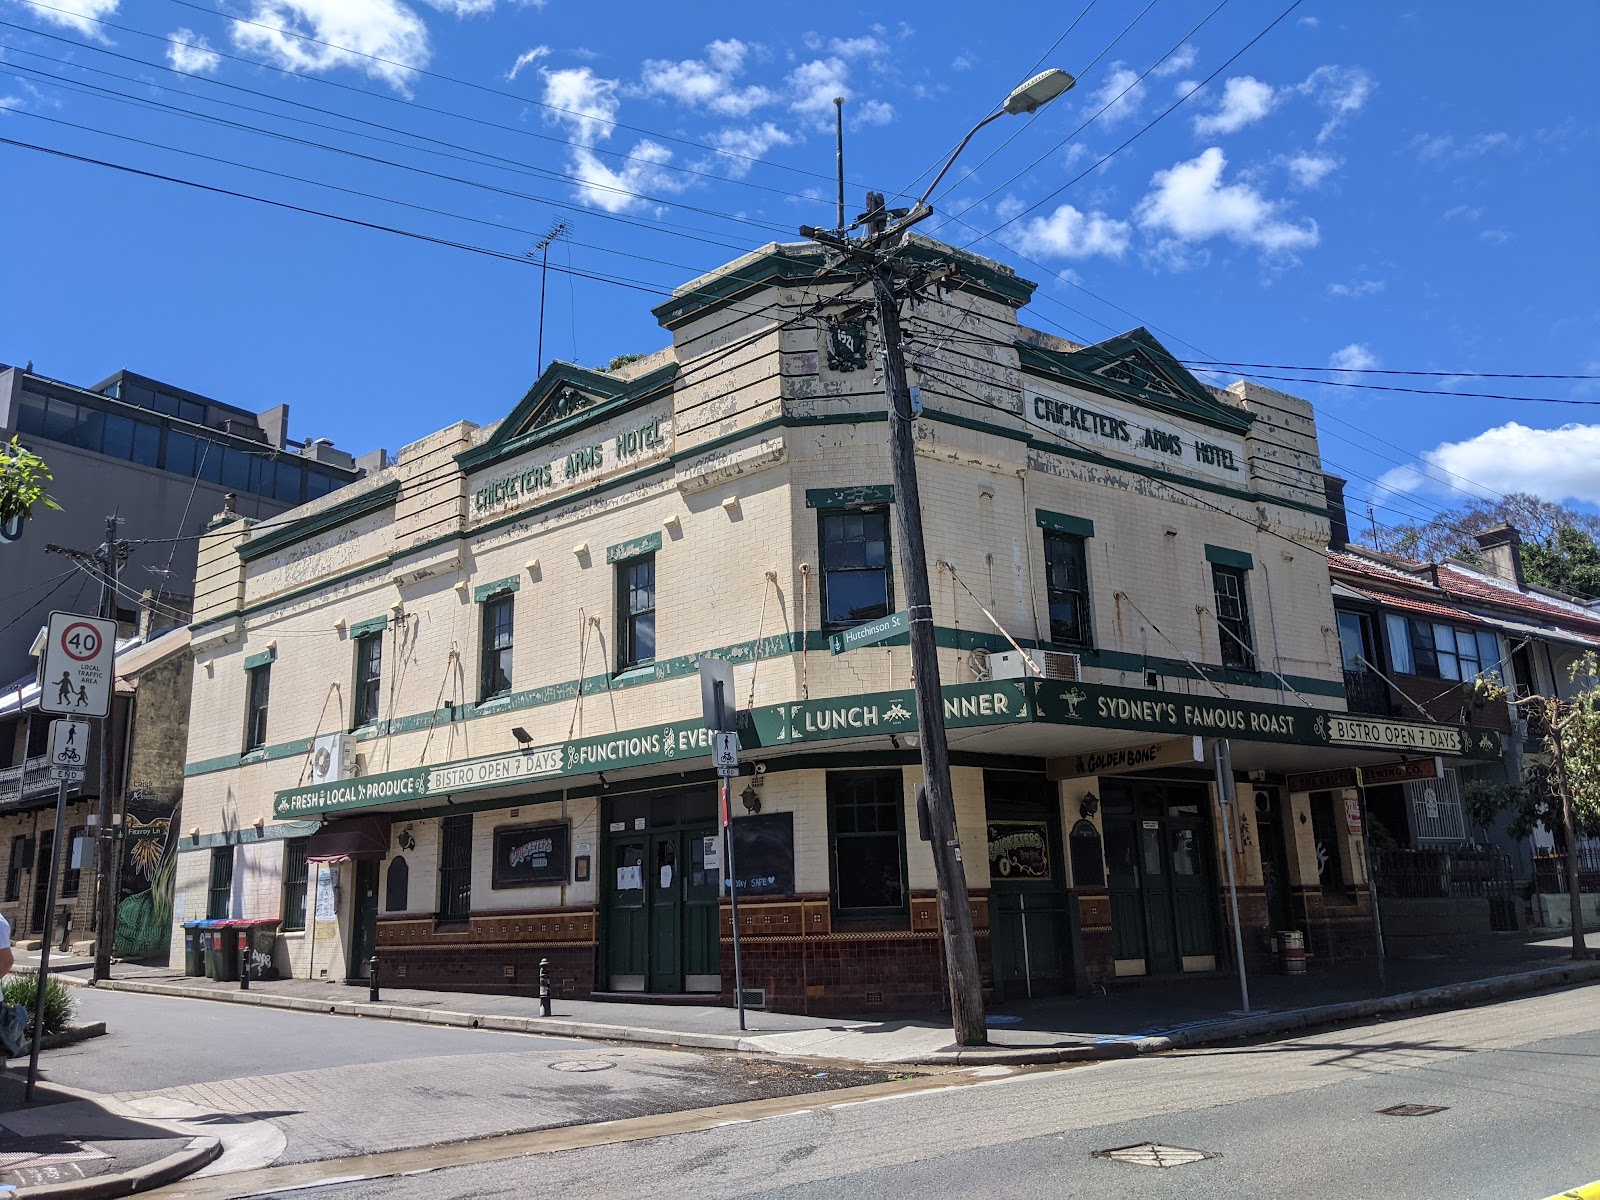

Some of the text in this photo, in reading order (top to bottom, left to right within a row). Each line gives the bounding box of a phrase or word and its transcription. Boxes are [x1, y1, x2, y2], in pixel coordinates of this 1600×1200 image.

[1034, 397, 1239, 471] CRICKETERS ARMS HOTEL
[475, 421, 663, 511] CRICKETERS ARMS HOTEL
[68, 633, 96, 651] 40
[846, 616, 901, 643] Hutchinson St
[78, 670, 103, 679] TRAFFIC
[81, 664, 101, 672] LOCAL
[81, 677, 98, 685] AREA
[805, 693, 1009, 732] LUNCH NNER
[1098, 696, 1295, 735] SYDNEY'S FAMOUS ROAST
[1337, 721, 1456, 748] BISTRO OPEN 7 DAYS
[580, 734, 660, 764] FUNCTIONS
[1088, 745, 1156, 773] GOLDEN BONE
[58, 771, 77, 779] END
[435, 753, 557, 788] BISTRO OPEN 7 DAYS
[291, 777, 414, 811] FRESH LOCAL PRODUCE
[751, 878, 767, 887] SAFE
